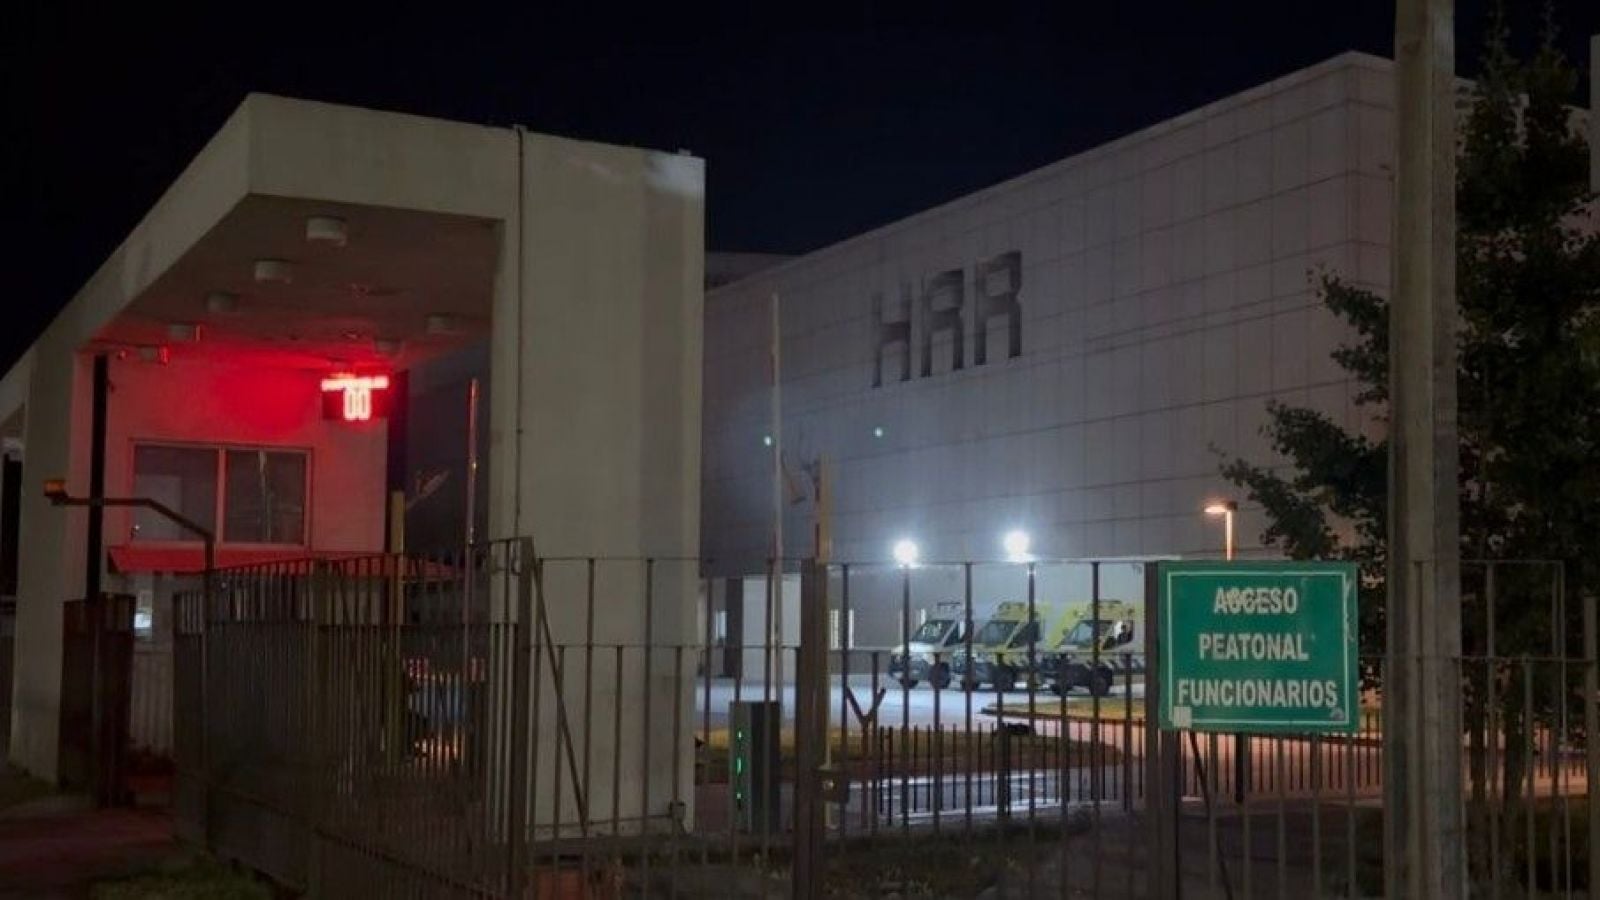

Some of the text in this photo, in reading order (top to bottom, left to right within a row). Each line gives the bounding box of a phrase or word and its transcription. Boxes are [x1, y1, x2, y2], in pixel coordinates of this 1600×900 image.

[1213, 587, 1298, 614] ACCESO
[1198, 632, 1309, 661] PEATONAL
[1178, 679, 1338, 708] FUNCIONARIOS
